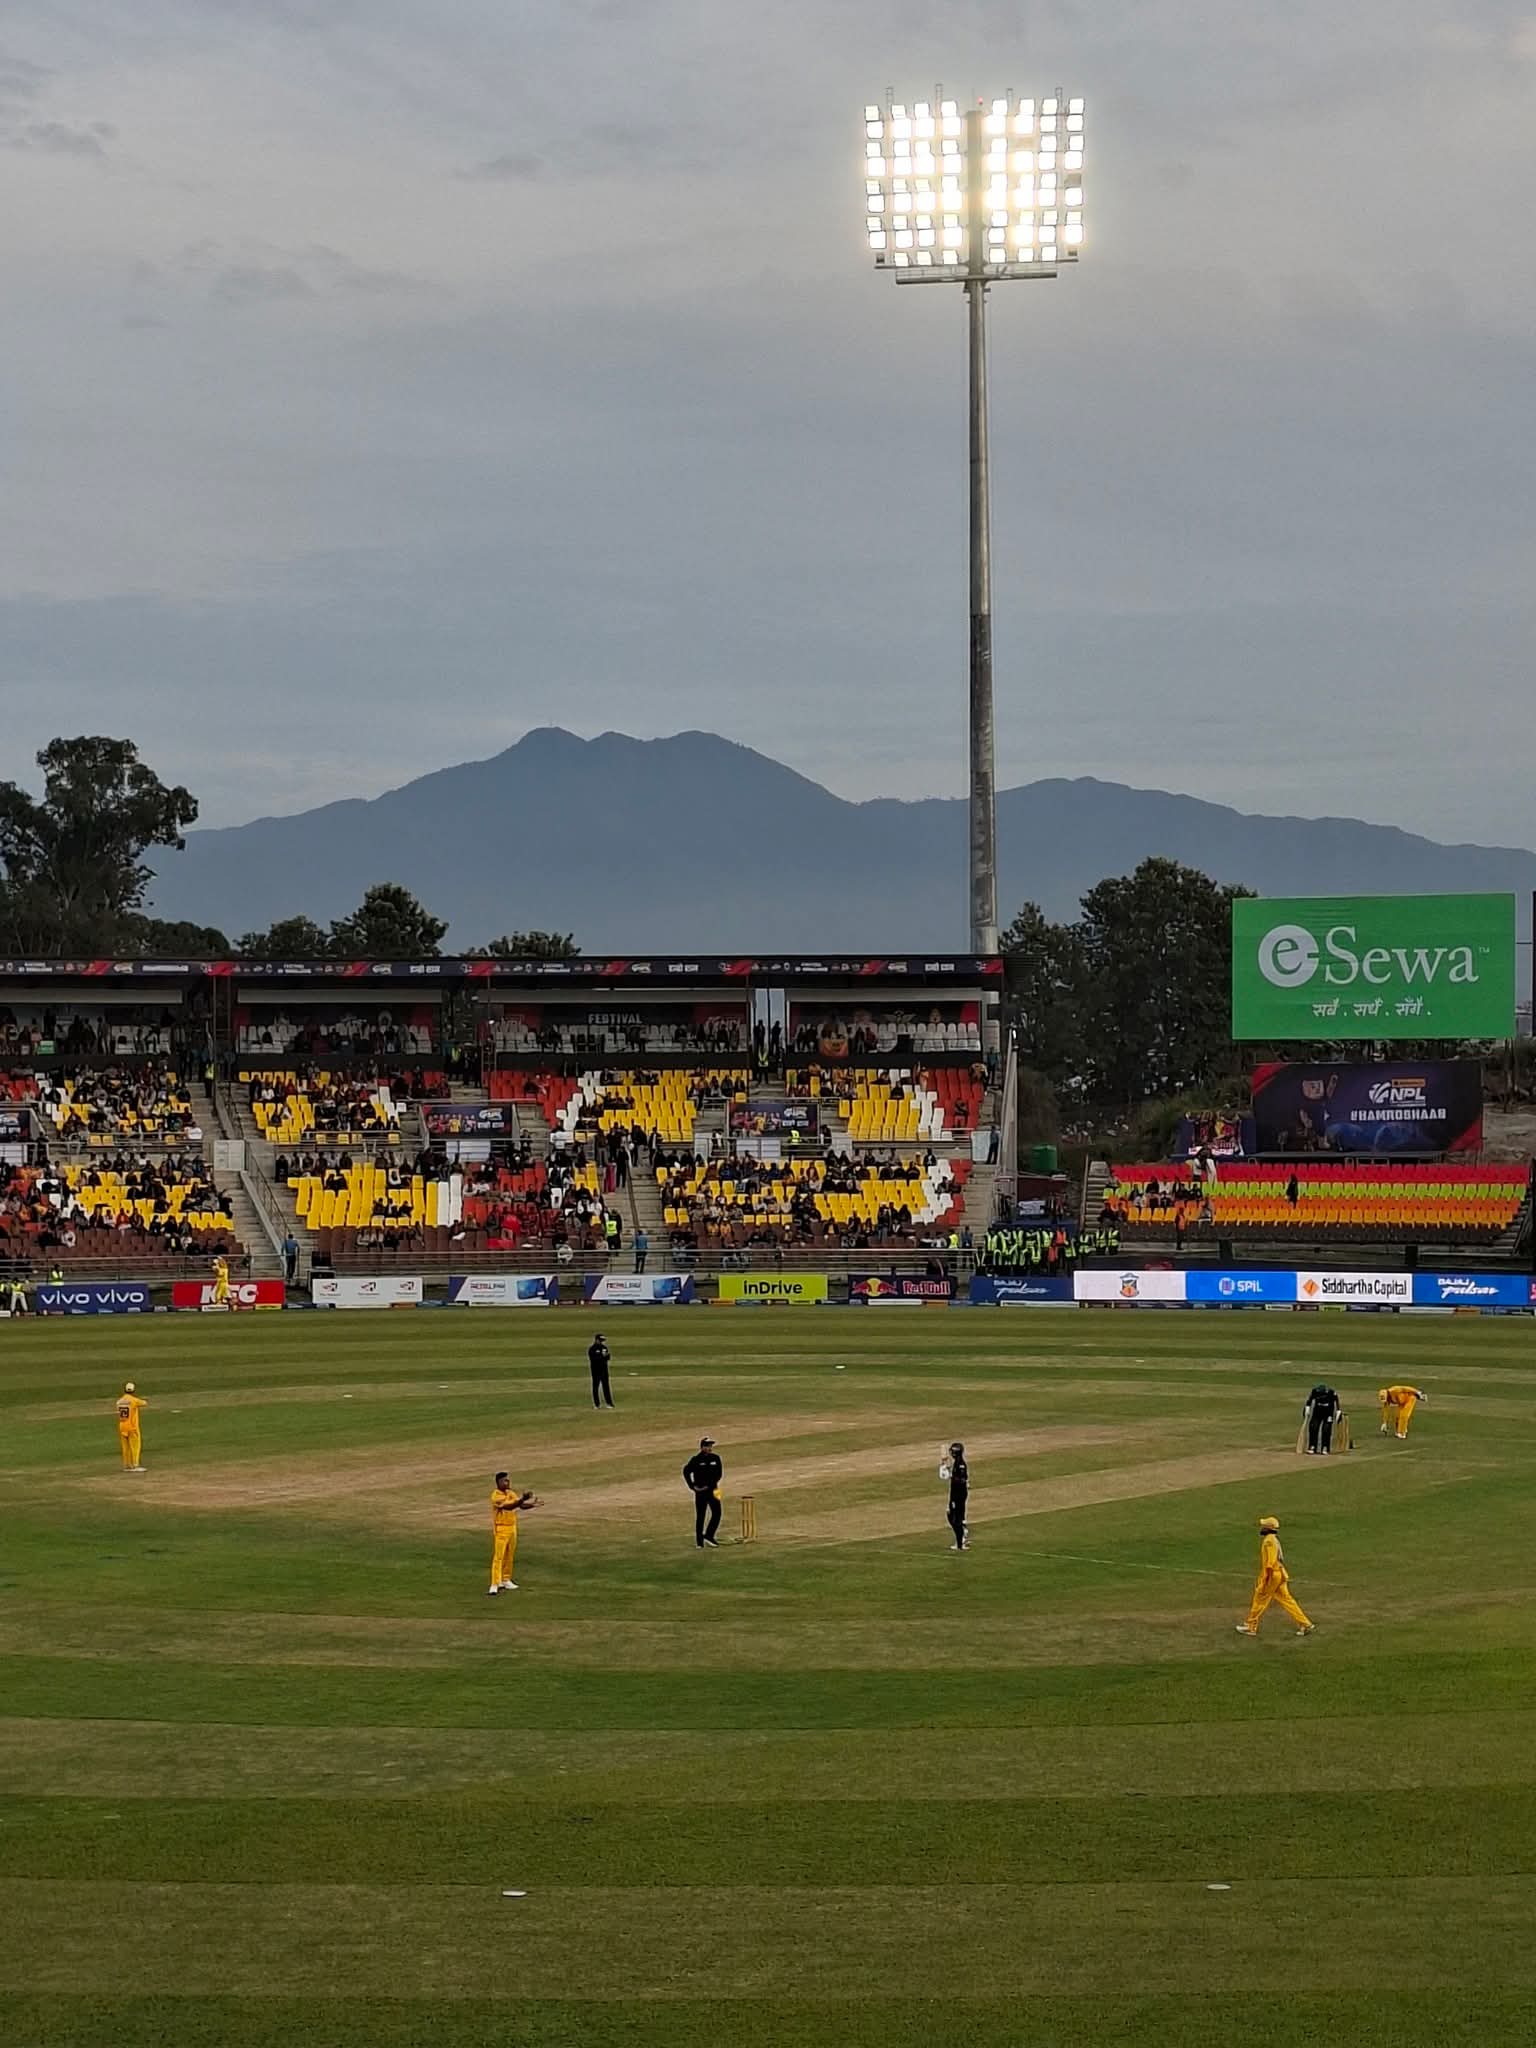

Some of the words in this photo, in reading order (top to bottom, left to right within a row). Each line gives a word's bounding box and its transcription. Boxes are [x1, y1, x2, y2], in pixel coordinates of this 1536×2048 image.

[1258, 925, 1479, 987] eSewa
[1390, 1087, 1426, 1101] NPL
[743, 1280, 804, 1294] inDrive
[1321, 1279, 1373, 1294] Siddhartha
[1374, 1279, 1407, 1298] Capital
[41, 1290, 90, 1305] vivo
[96, 1289, 144, 1304] vivo
